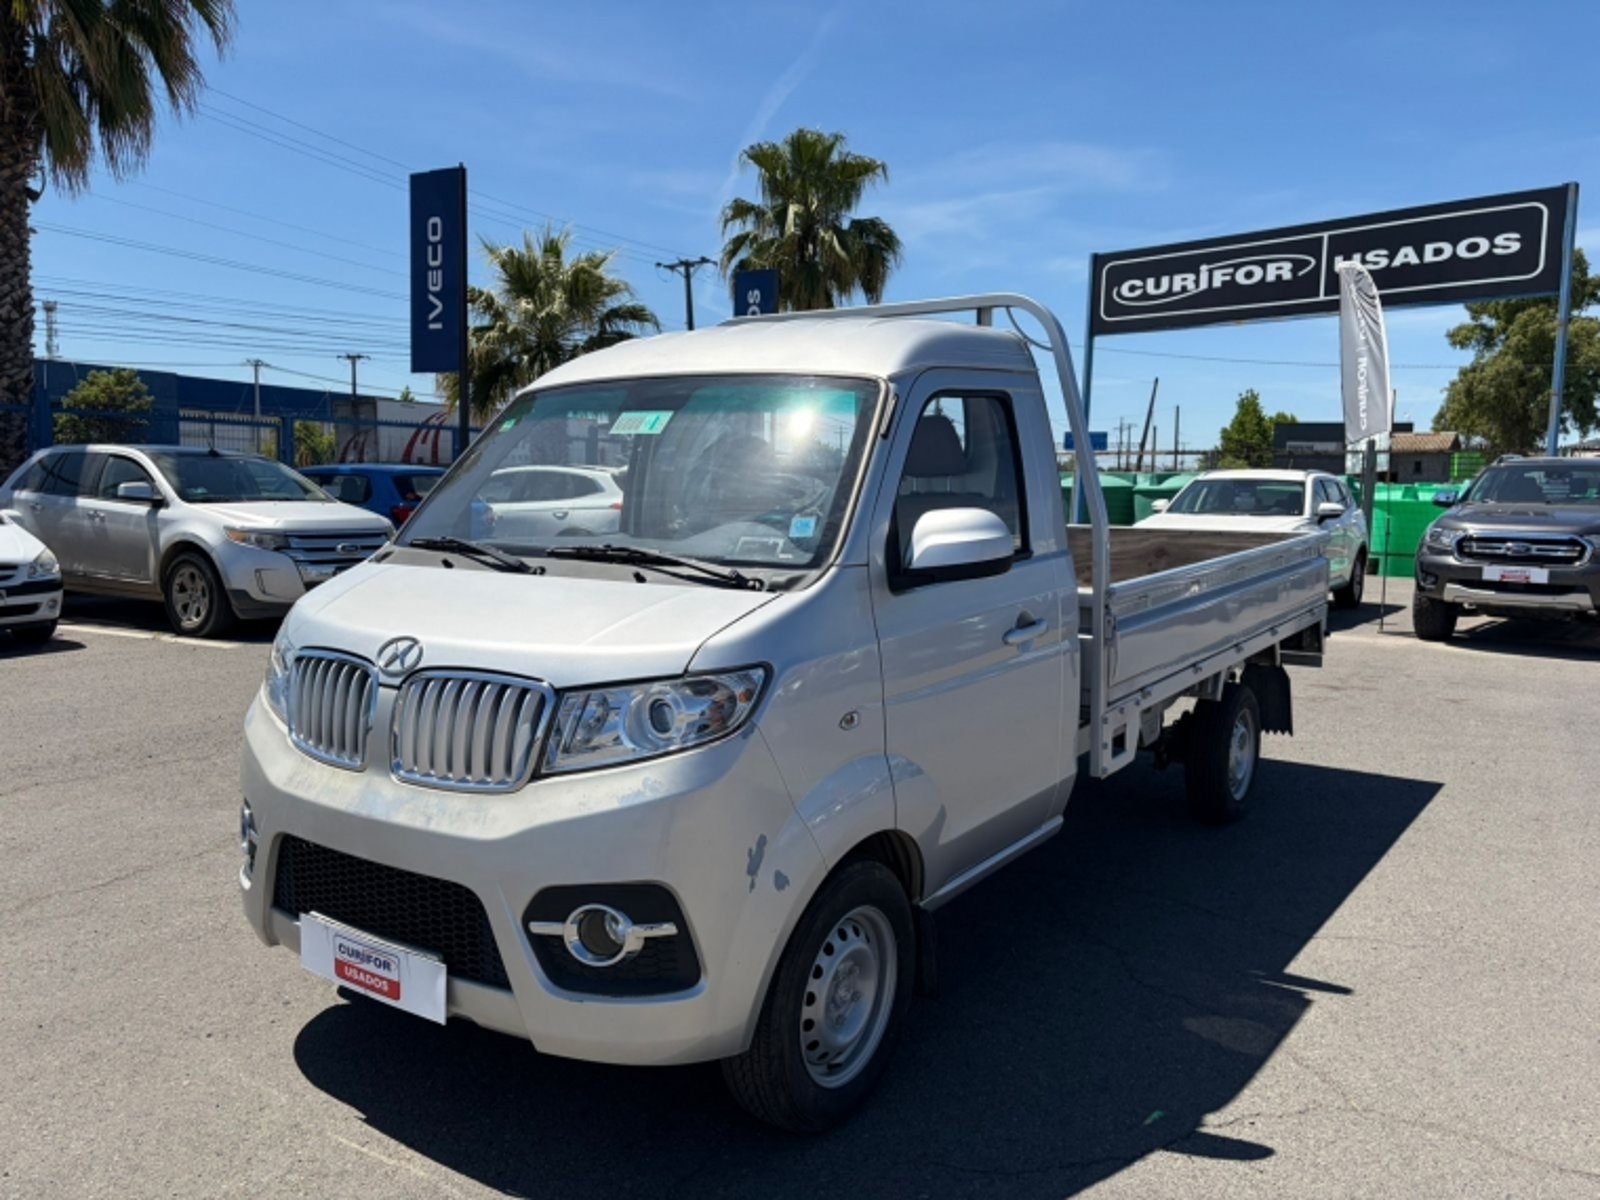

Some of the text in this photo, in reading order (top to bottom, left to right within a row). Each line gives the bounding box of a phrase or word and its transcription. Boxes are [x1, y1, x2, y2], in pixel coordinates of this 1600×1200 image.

[425, 215, 443, 330] IVECO
[1119, 261, 1293, 298] CURIFOR
[338, 942, 392, 972] CURIFOR
[344, 965, 389, 992] USADOS
